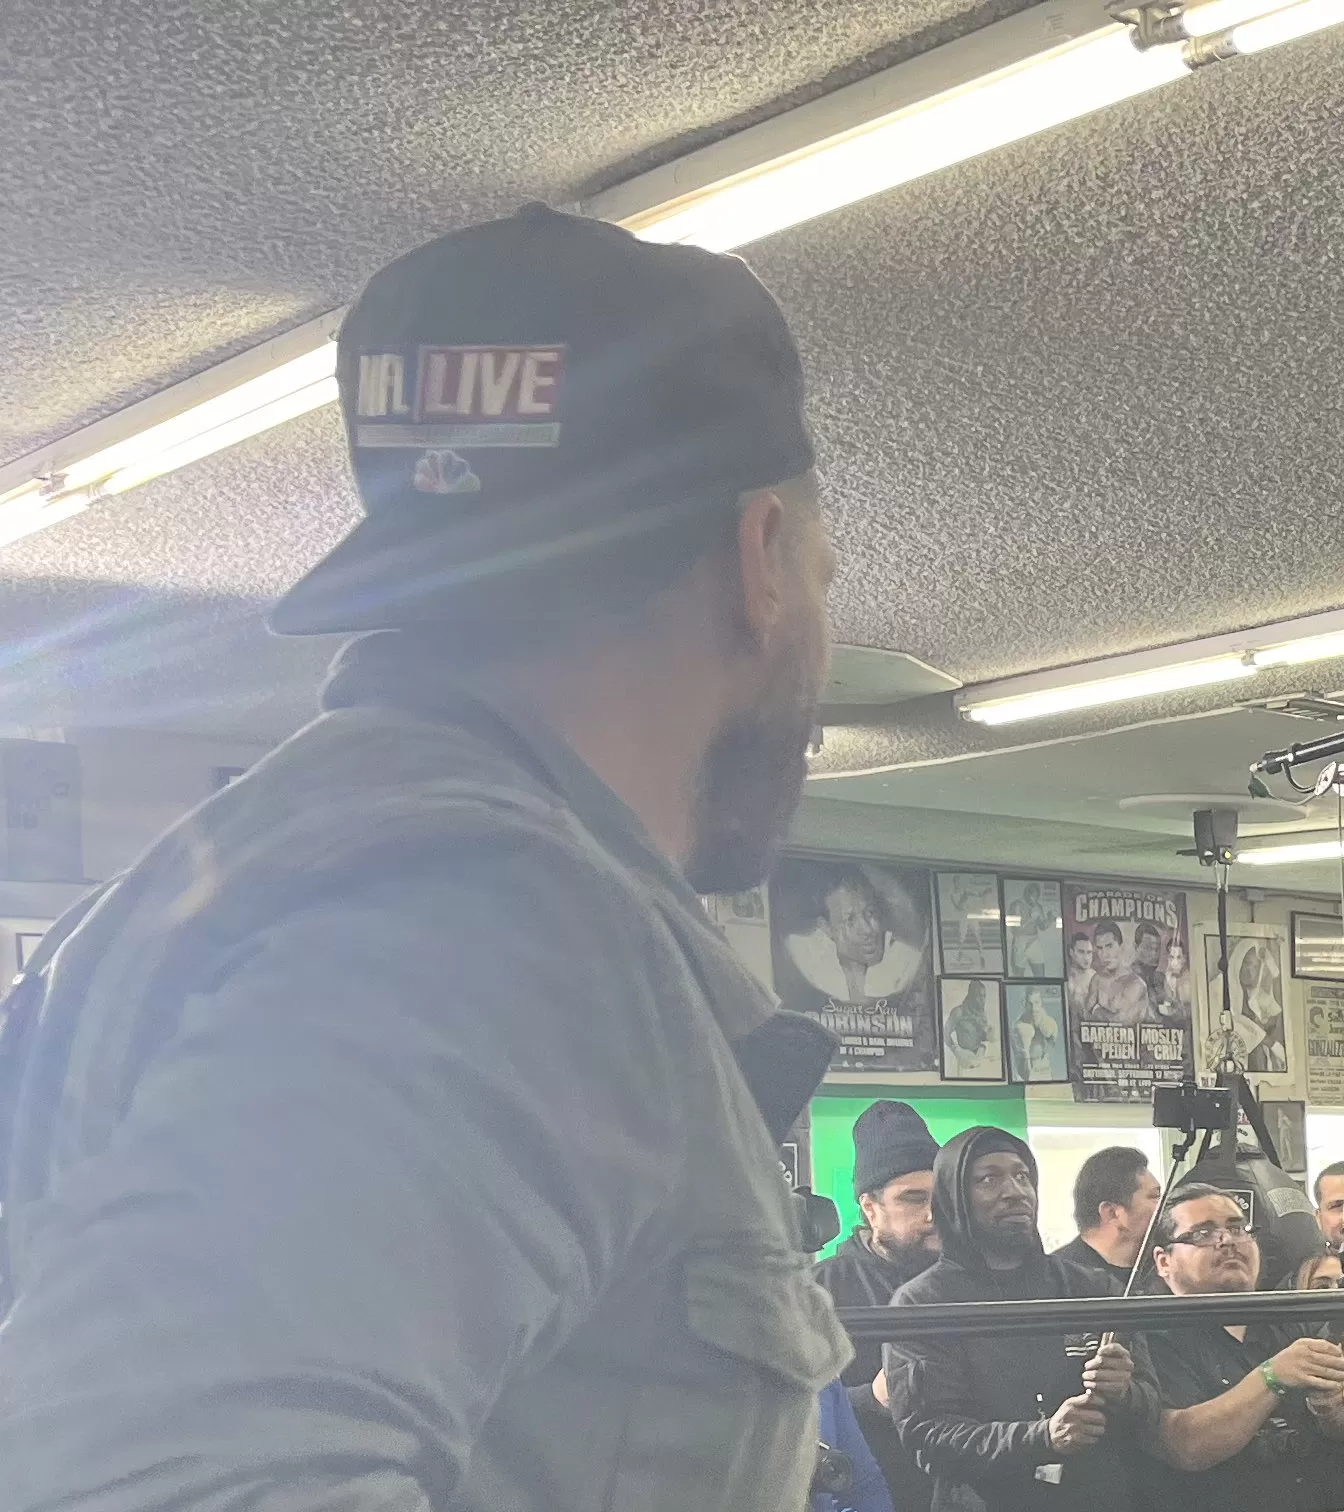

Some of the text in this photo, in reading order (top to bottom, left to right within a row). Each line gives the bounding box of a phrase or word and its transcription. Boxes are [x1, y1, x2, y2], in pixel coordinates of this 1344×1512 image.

[425, 352, 558, 415] LIVE
[1076, 894, 1178, 929] CHAMPIONS
[1081, 1026, 1136, 1044] BARRERA
[1154, 1044, 1184, 1061] CRUZ
